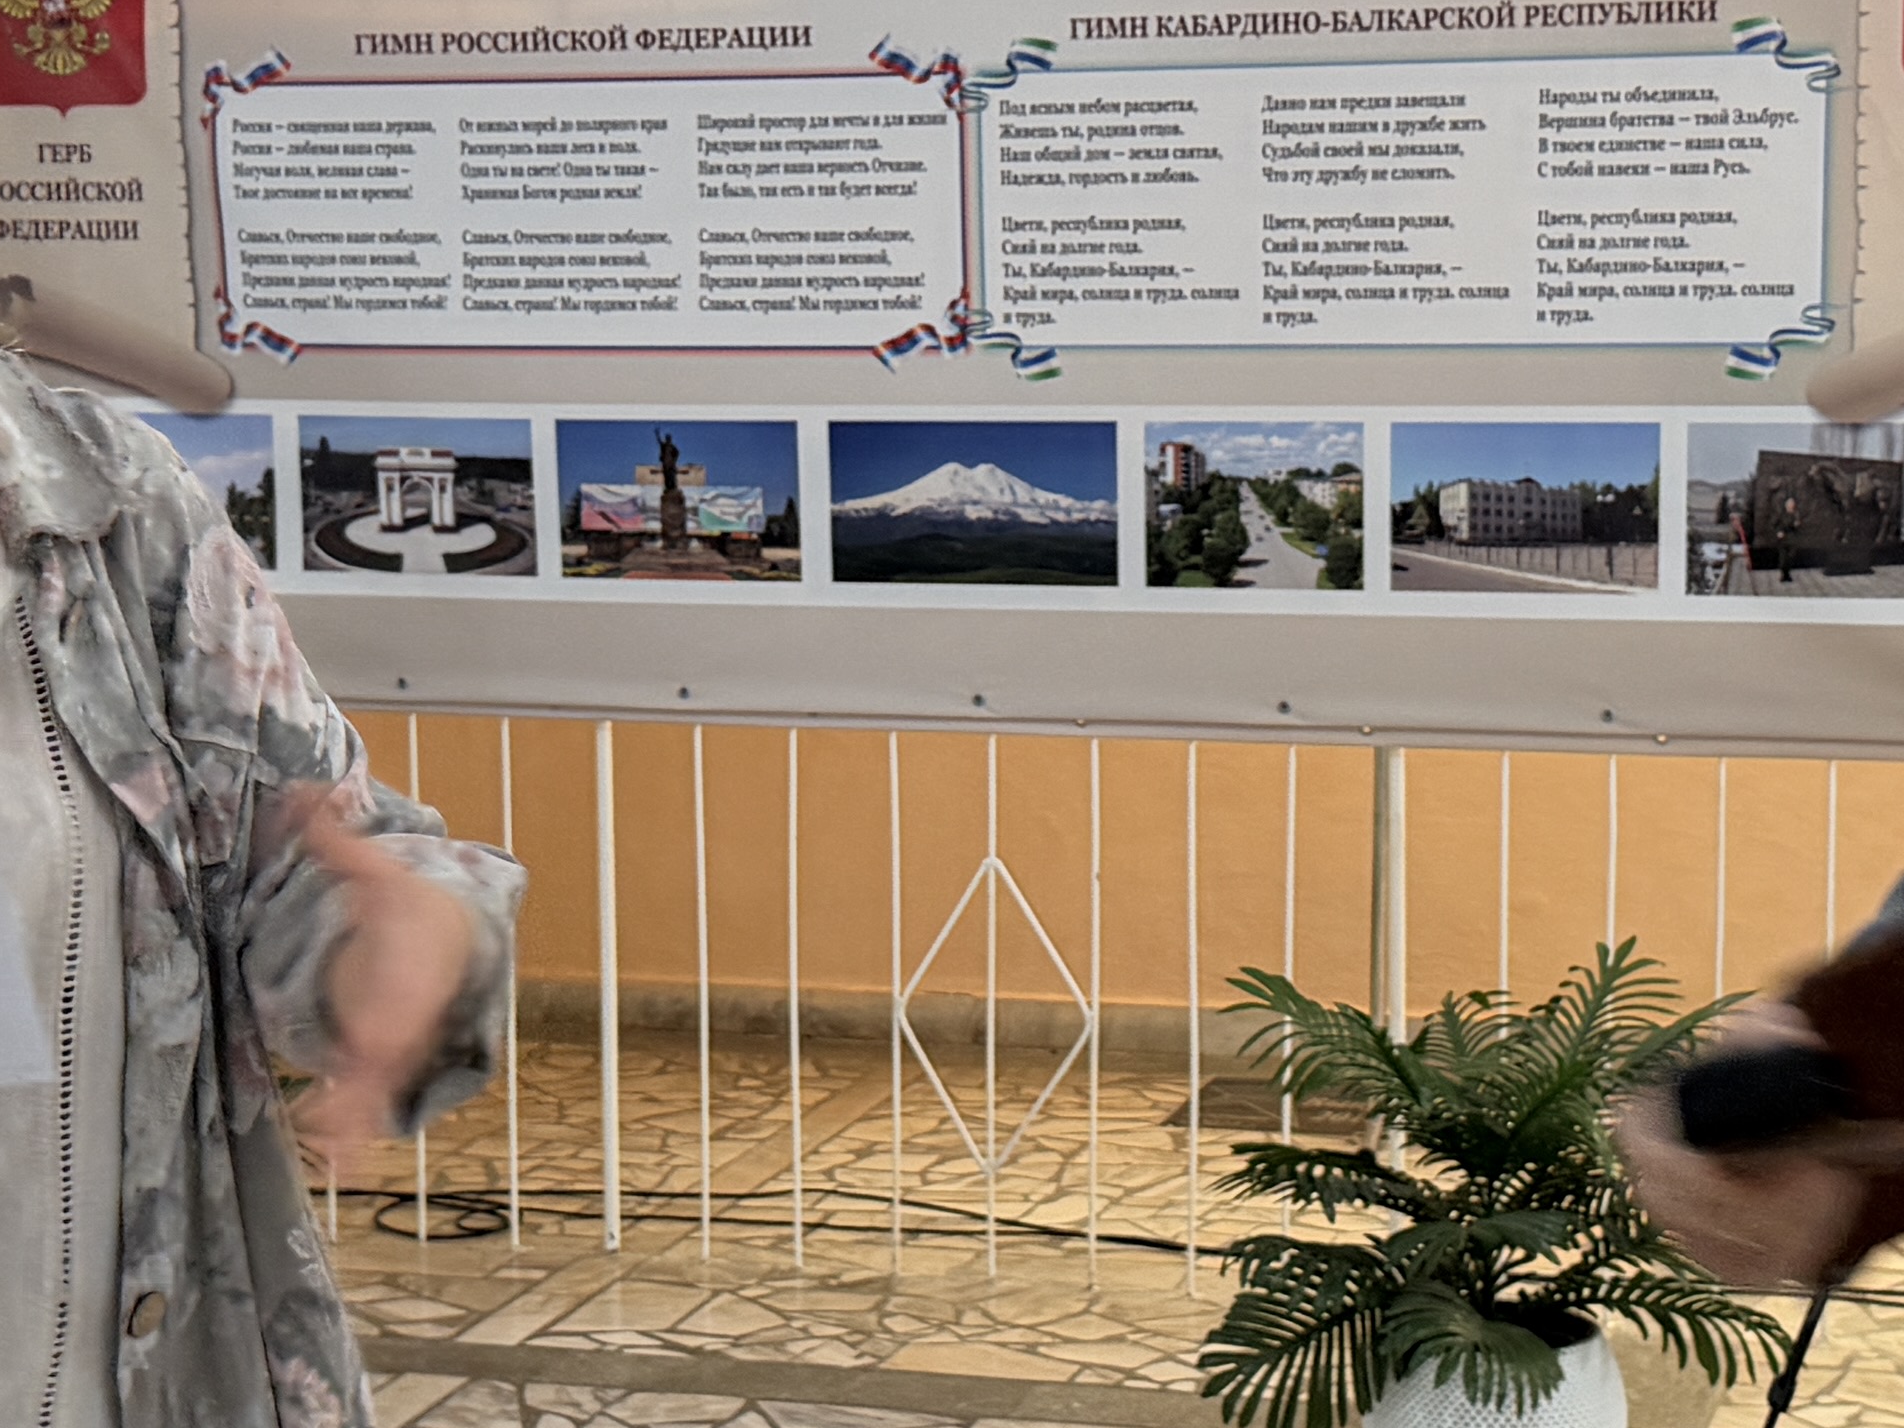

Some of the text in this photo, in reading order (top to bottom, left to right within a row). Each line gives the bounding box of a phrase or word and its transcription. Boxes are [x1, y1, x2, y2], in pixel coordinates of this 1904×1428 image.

[1069, 16, 1150, 40] ГИМН
[1154, 2, 1517, 40] КАБАРДИНО-БАЛКАРСКОЙ
[354, 25, 813, 56] ГИМН РОССИЙСКОЙ ФЕДЕРАЦИИ
[38, 142, 93, 164] ГЕРБ
